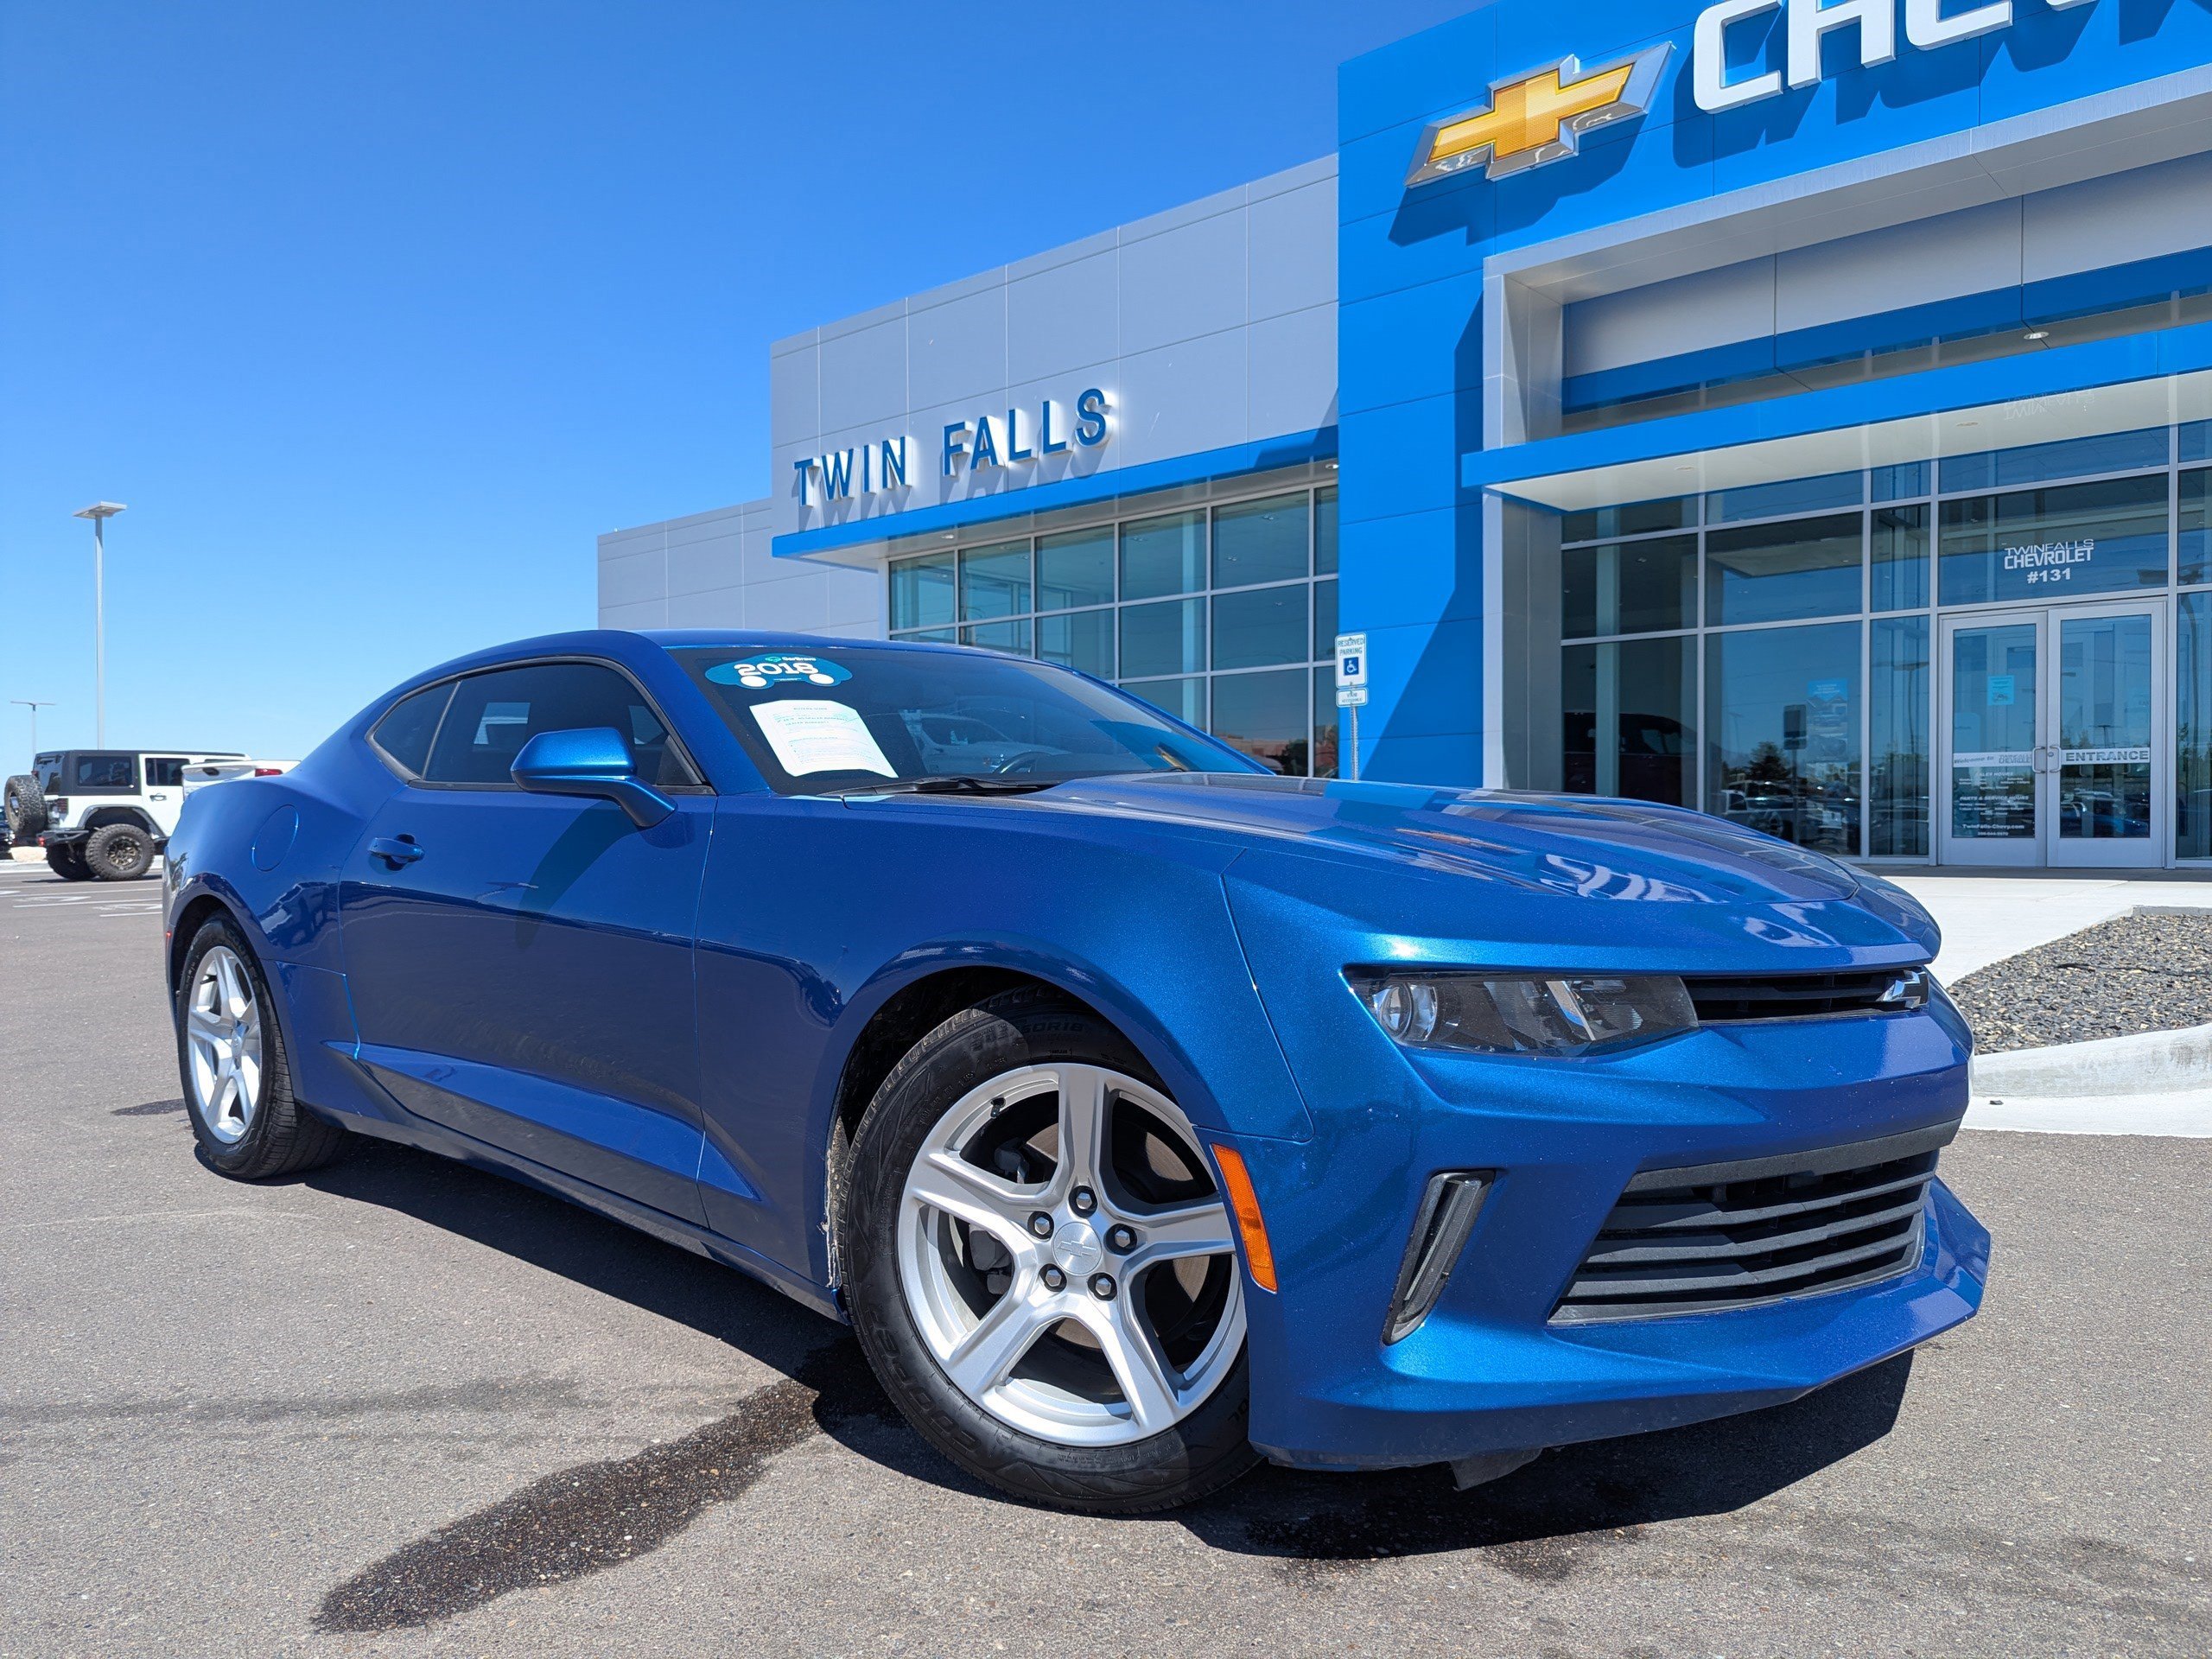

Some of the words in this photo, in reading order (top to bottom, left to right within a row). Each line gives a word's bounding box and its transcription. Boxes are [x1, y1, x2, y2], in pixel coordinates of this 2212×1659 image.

[1694, 0, 2101, 114] CH
[794, 435, 912, 507] TWIN
[942, 388, 1113, 477] FALLS
[2005, 538, 2094, 556] TWINFALLS
[2005, 547, 2094, 569] CHEVROLET
[2027, 568, 2071, 583] #131
[1337, 638, 1364, 647] RESERVED
[1339, 647, 1363, 656] PARKING
[734, 662, 819, 677] 2018
[2065, 750, 2149, 761] ENTRANCE
